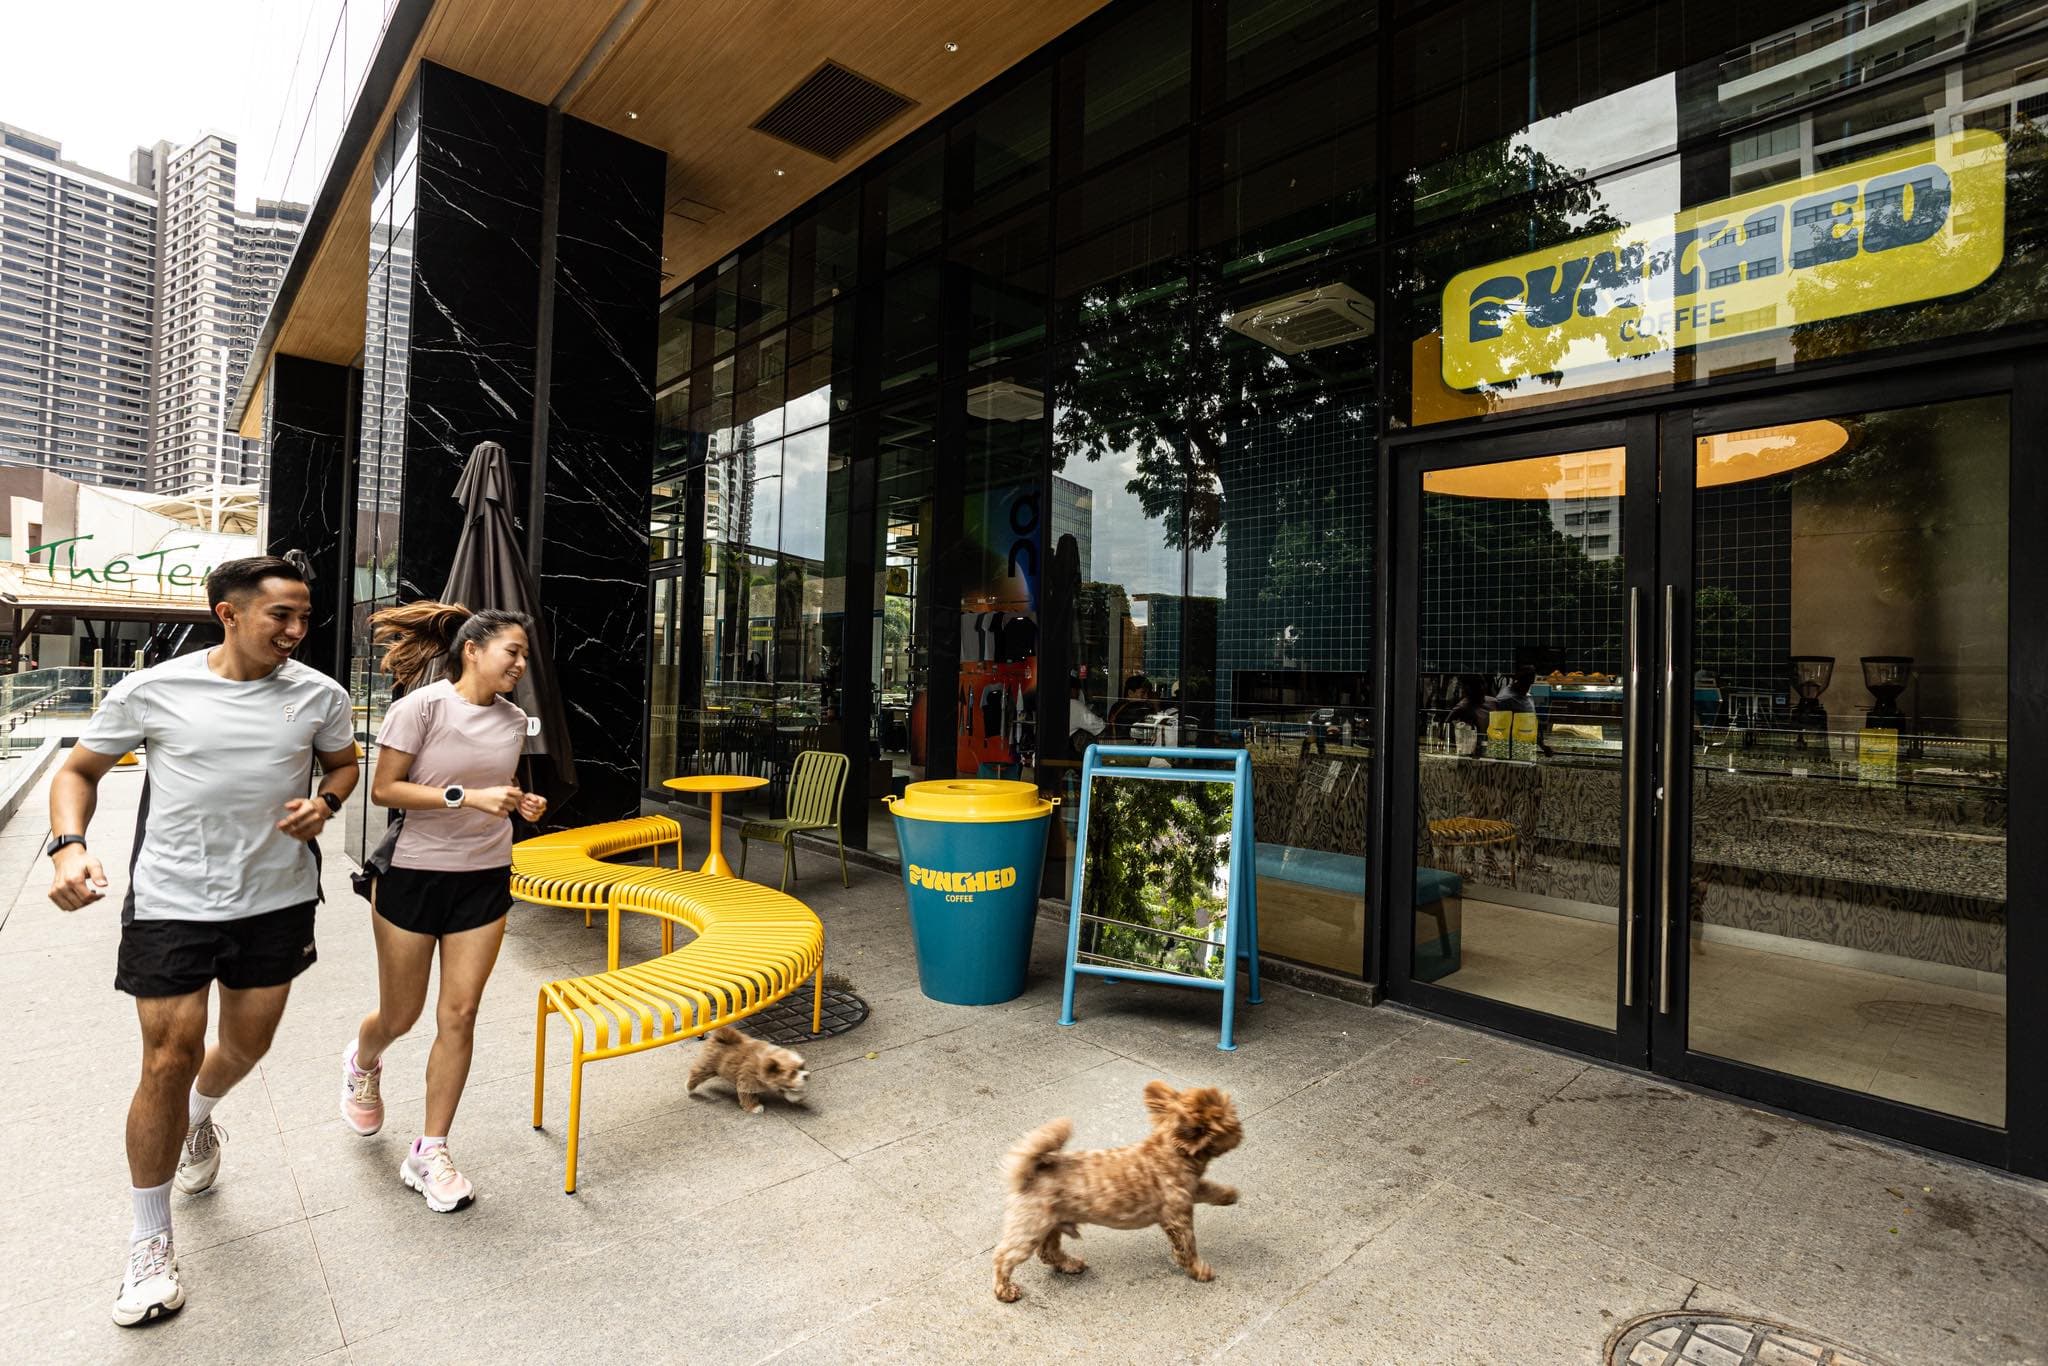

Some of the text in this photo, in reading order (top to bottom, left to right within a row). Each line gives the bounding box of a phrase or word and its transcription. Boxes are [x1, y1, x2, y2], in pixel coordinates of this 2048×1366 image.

[1619, 300, 1726, 343] COFFEE
[26, 534, 136, 584] The
[909, 864, 1016, 893] PUNCHED
[945, 894, 974, 903] COFFEE
